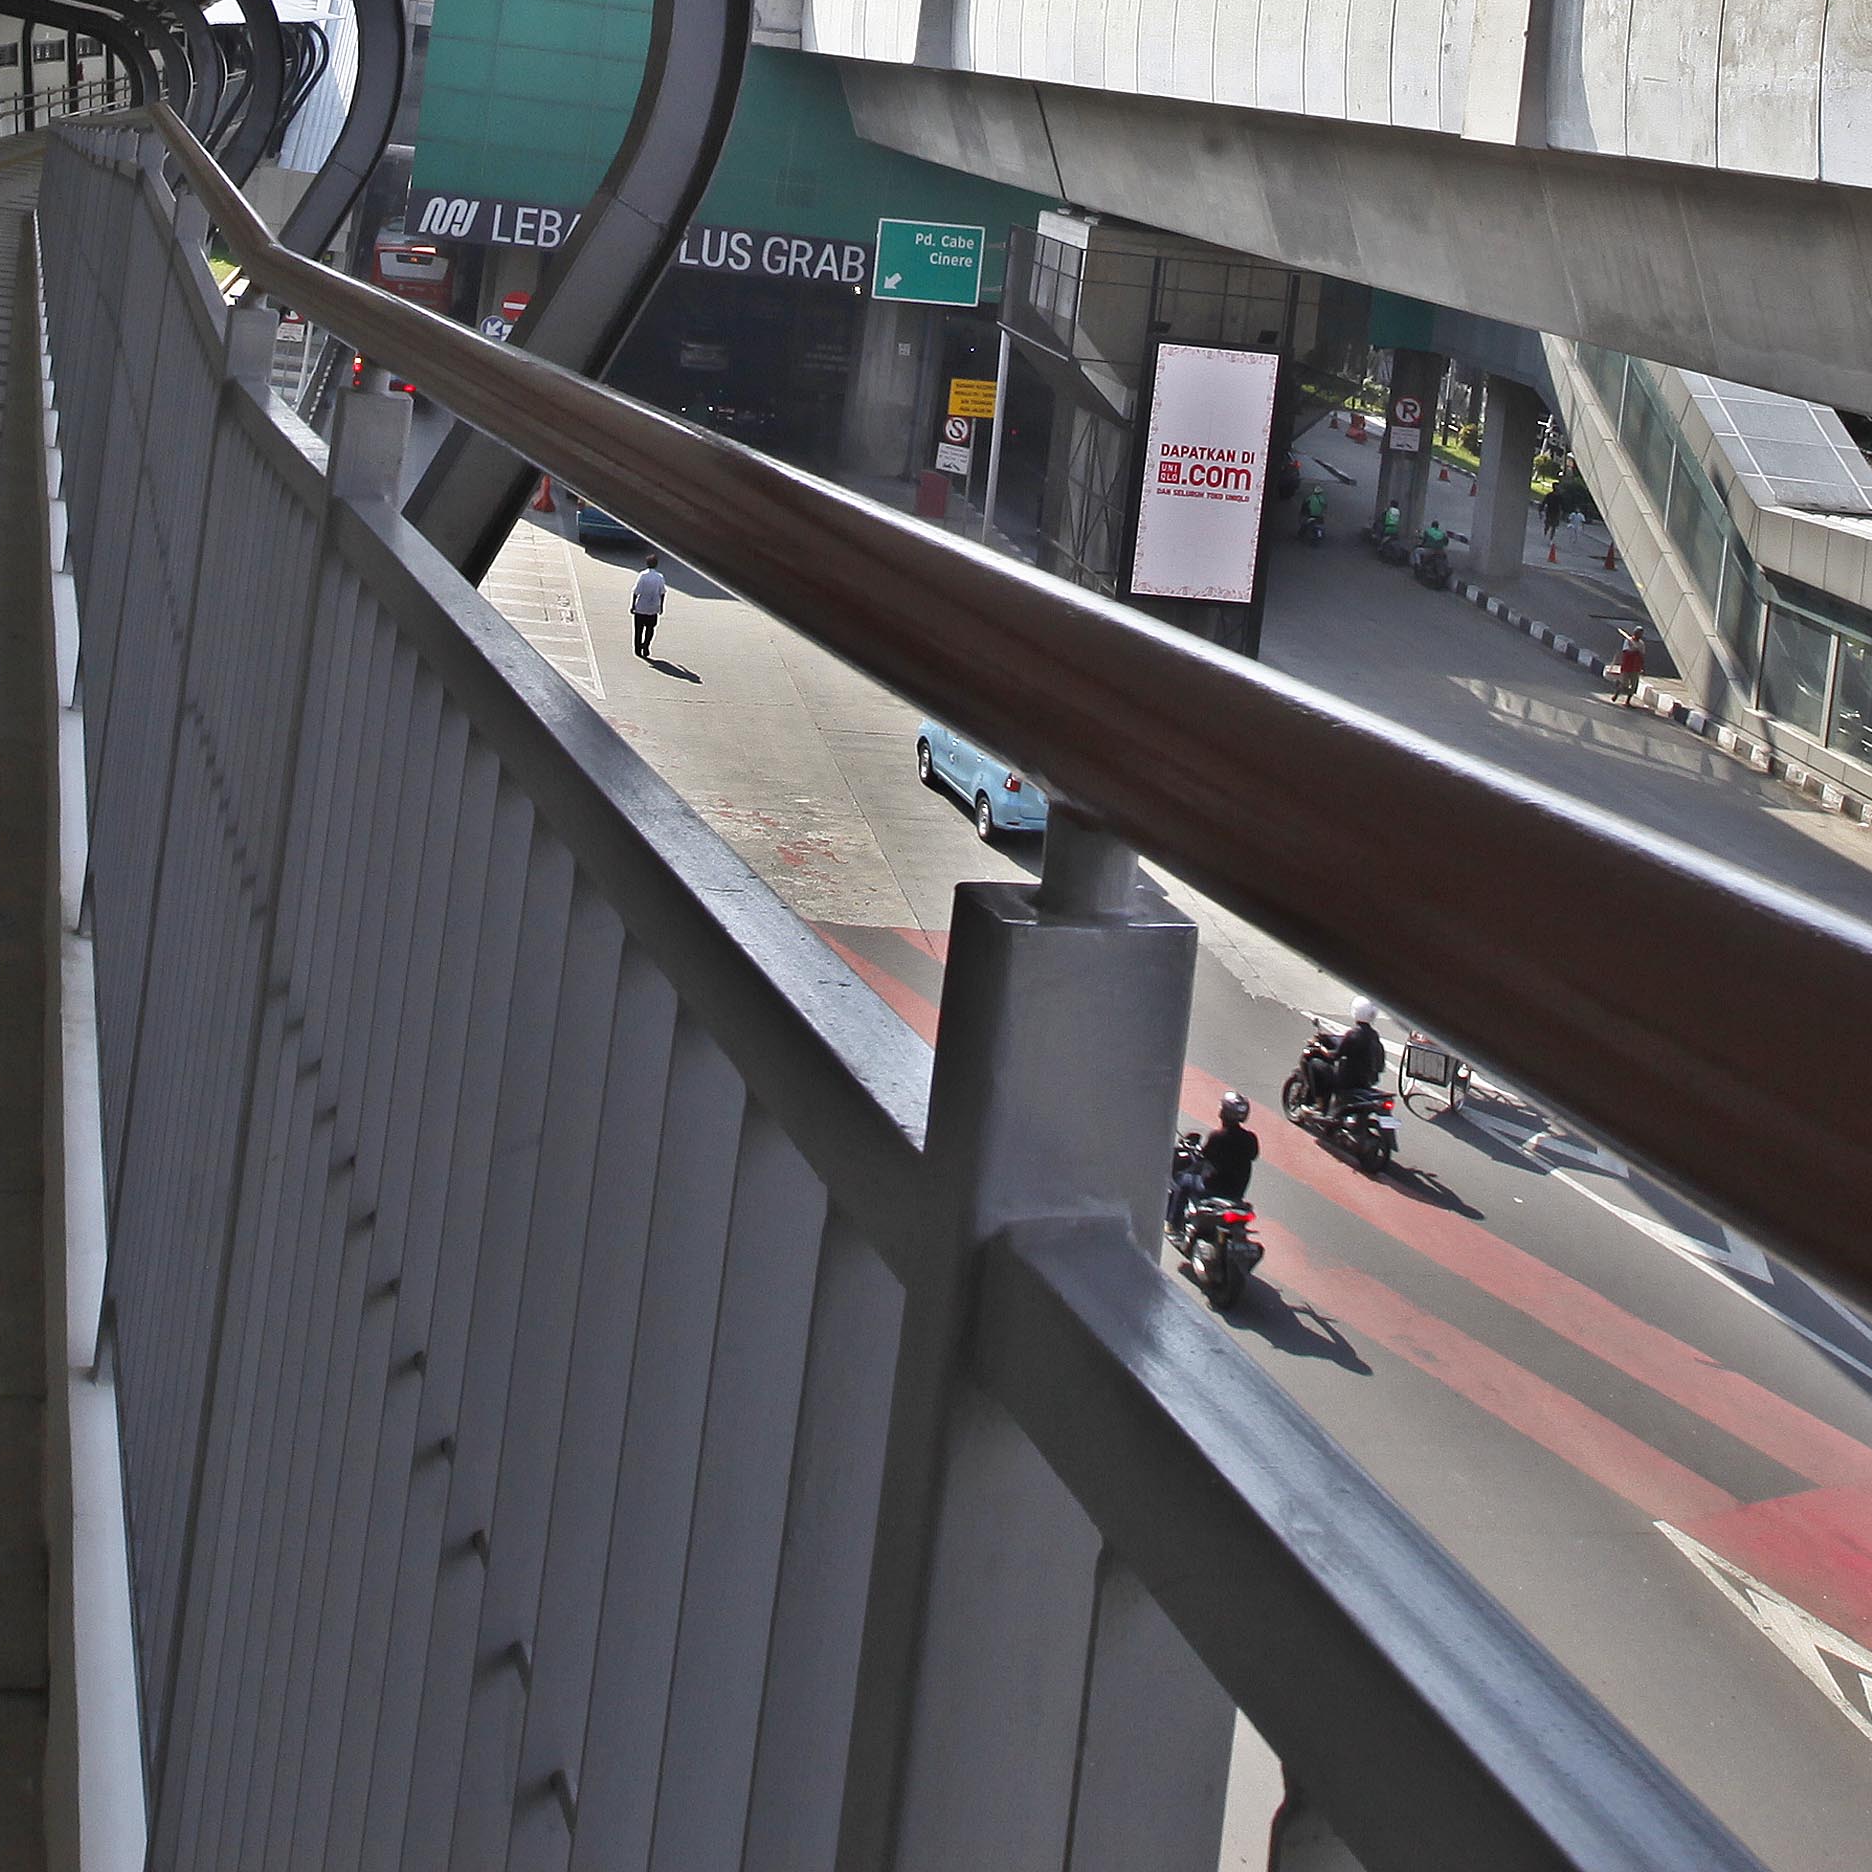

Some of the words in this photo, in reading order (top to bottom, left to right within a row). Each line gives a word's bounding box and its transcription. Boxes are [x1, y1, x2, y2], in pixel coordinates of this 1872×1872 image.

[916, 233, 936, 247] Pd.
[941, 235, 974, 249] Cabe
[679, 228, 753, 271] LUS
[762, 236, 866, 283] GRAB
[929, 252, 973, 267] Cinere
[1161, 444, 1236, 462] DAPATKAN
[1241, 451, 1255, 464] DI
[1160, 472, 1178, 481] QLO
[1181, 464, 1252, 490] .com
